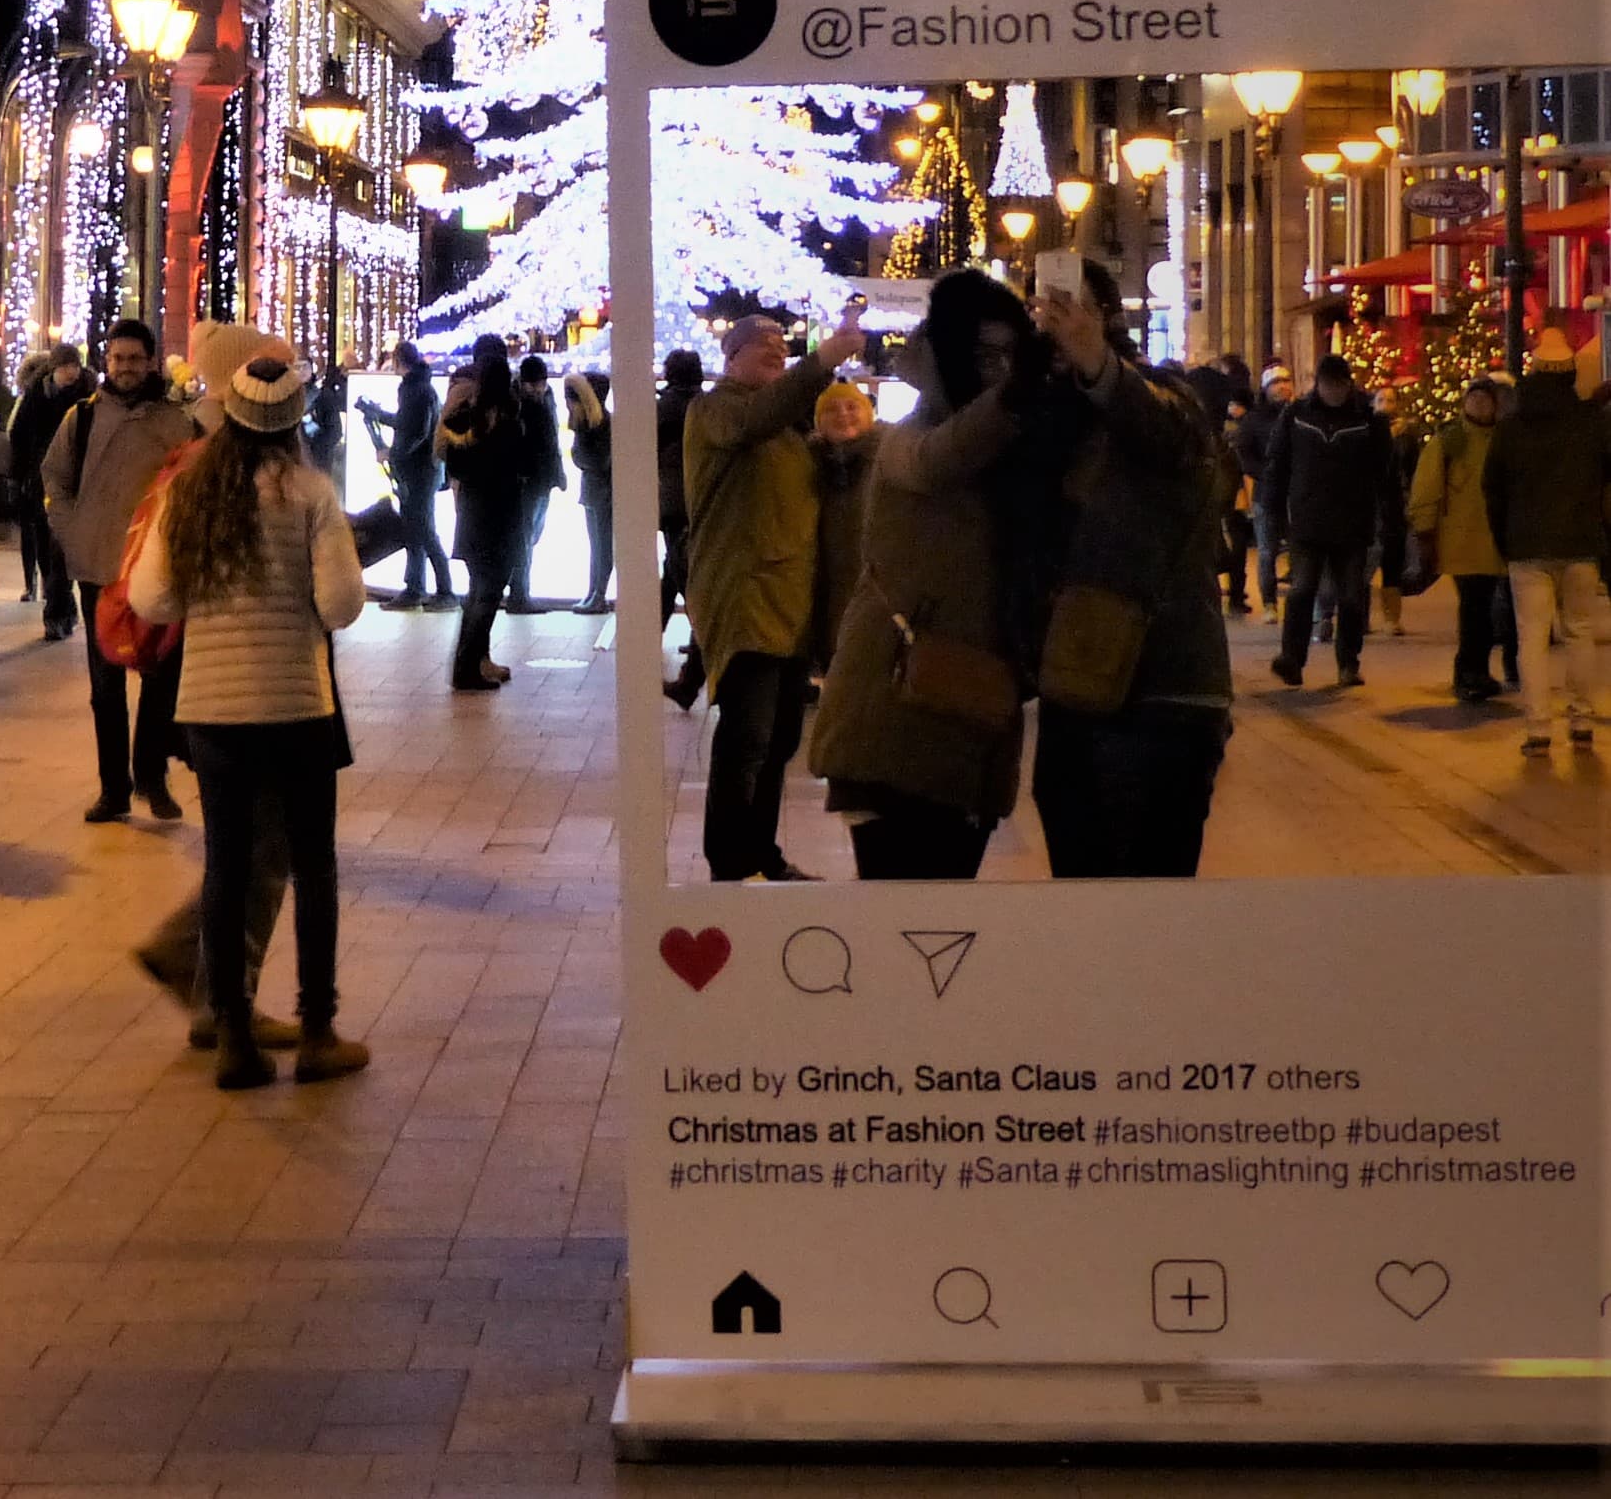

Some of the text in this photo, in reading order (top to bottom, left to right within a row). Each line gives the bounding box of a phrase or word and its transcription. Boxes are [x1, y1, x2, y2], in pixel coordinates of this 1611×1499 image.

[801, 0, 1223, 62] @Fashion Street
[663, 1062, 1361, 1100] Liked by Grinch, Santa Claus and 2017 others
[667, 1113, 1502, 1151] Christmas at Fashion Street #fashionstreetbp #budapest
[669, 1155, 1577, 1191] #christmas #charity #Santa #christmaslightning #christmastree
